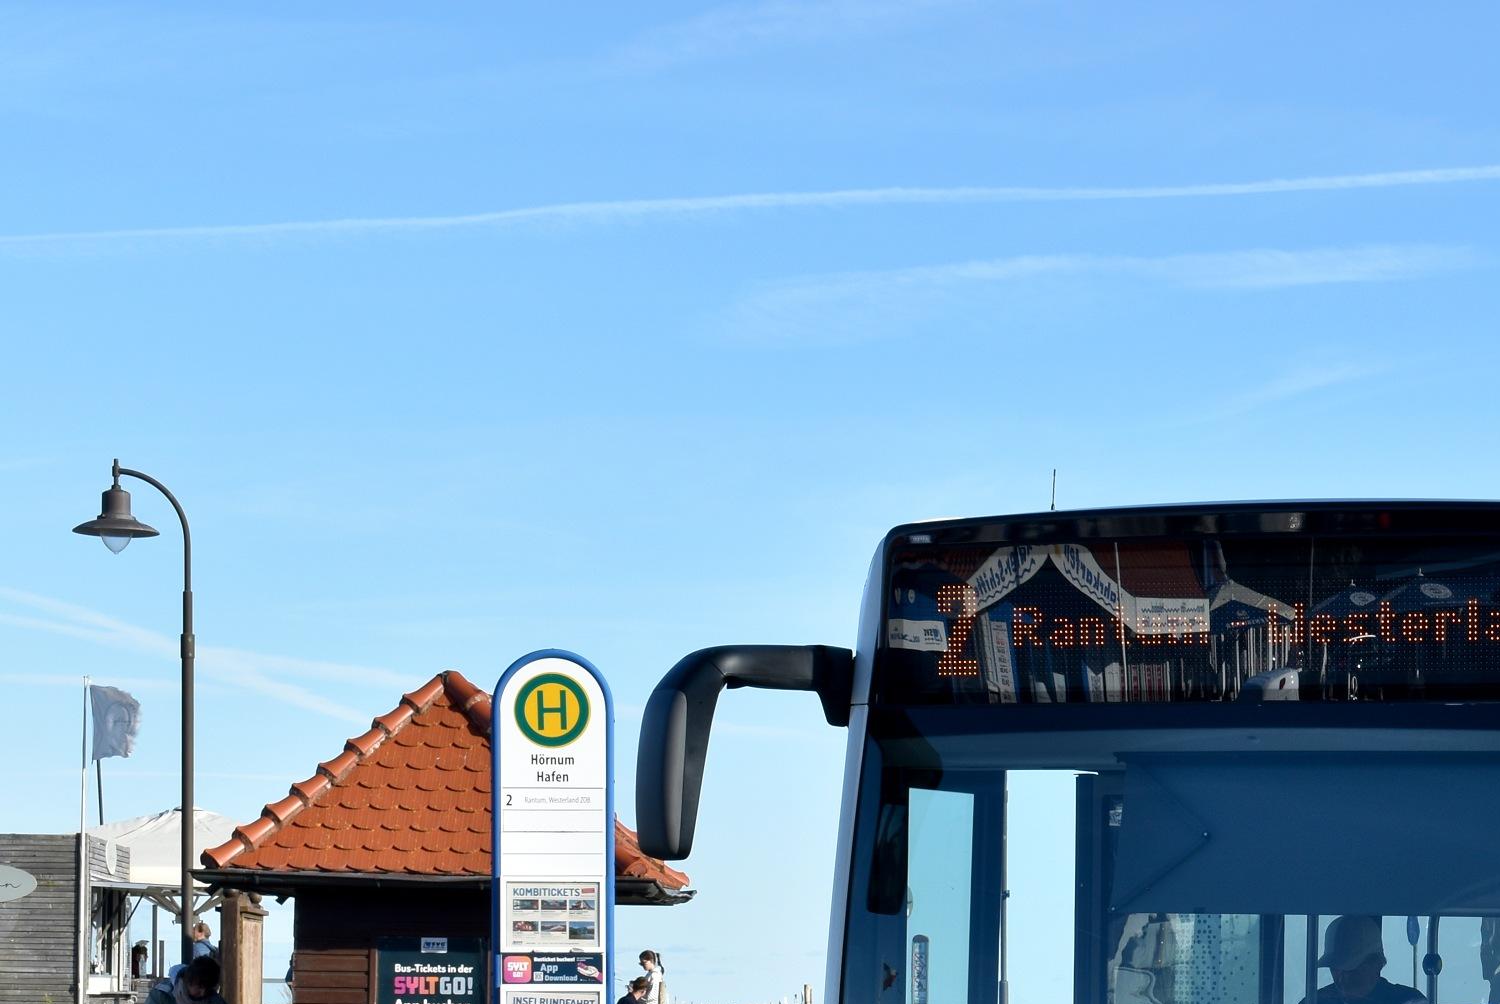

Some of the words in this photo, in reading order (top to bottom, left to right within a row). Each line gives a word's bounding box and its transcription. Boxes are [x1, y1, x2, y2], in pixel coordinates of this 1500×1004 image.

[937, 585, 977, 676] 2
[1013, 607, 1208, 645] Rantum
[537, 689, 567, 730] H
[531, 754, 575, 765] Hörnum
[537, 771, 569, 782] Hafen
[506, 794, 513, 806] 2
[549, 796, 579, 804] Westerland
[513, 887, 580, 897] KOMBITICKETS
[394, 964, 446, 973] Bus-Tickets
[448, 964, 457, 973] in
[458, 964, 474, 973] der
[507, 962, 529, 972] SYLT
[540, 963, 558, 973] App
